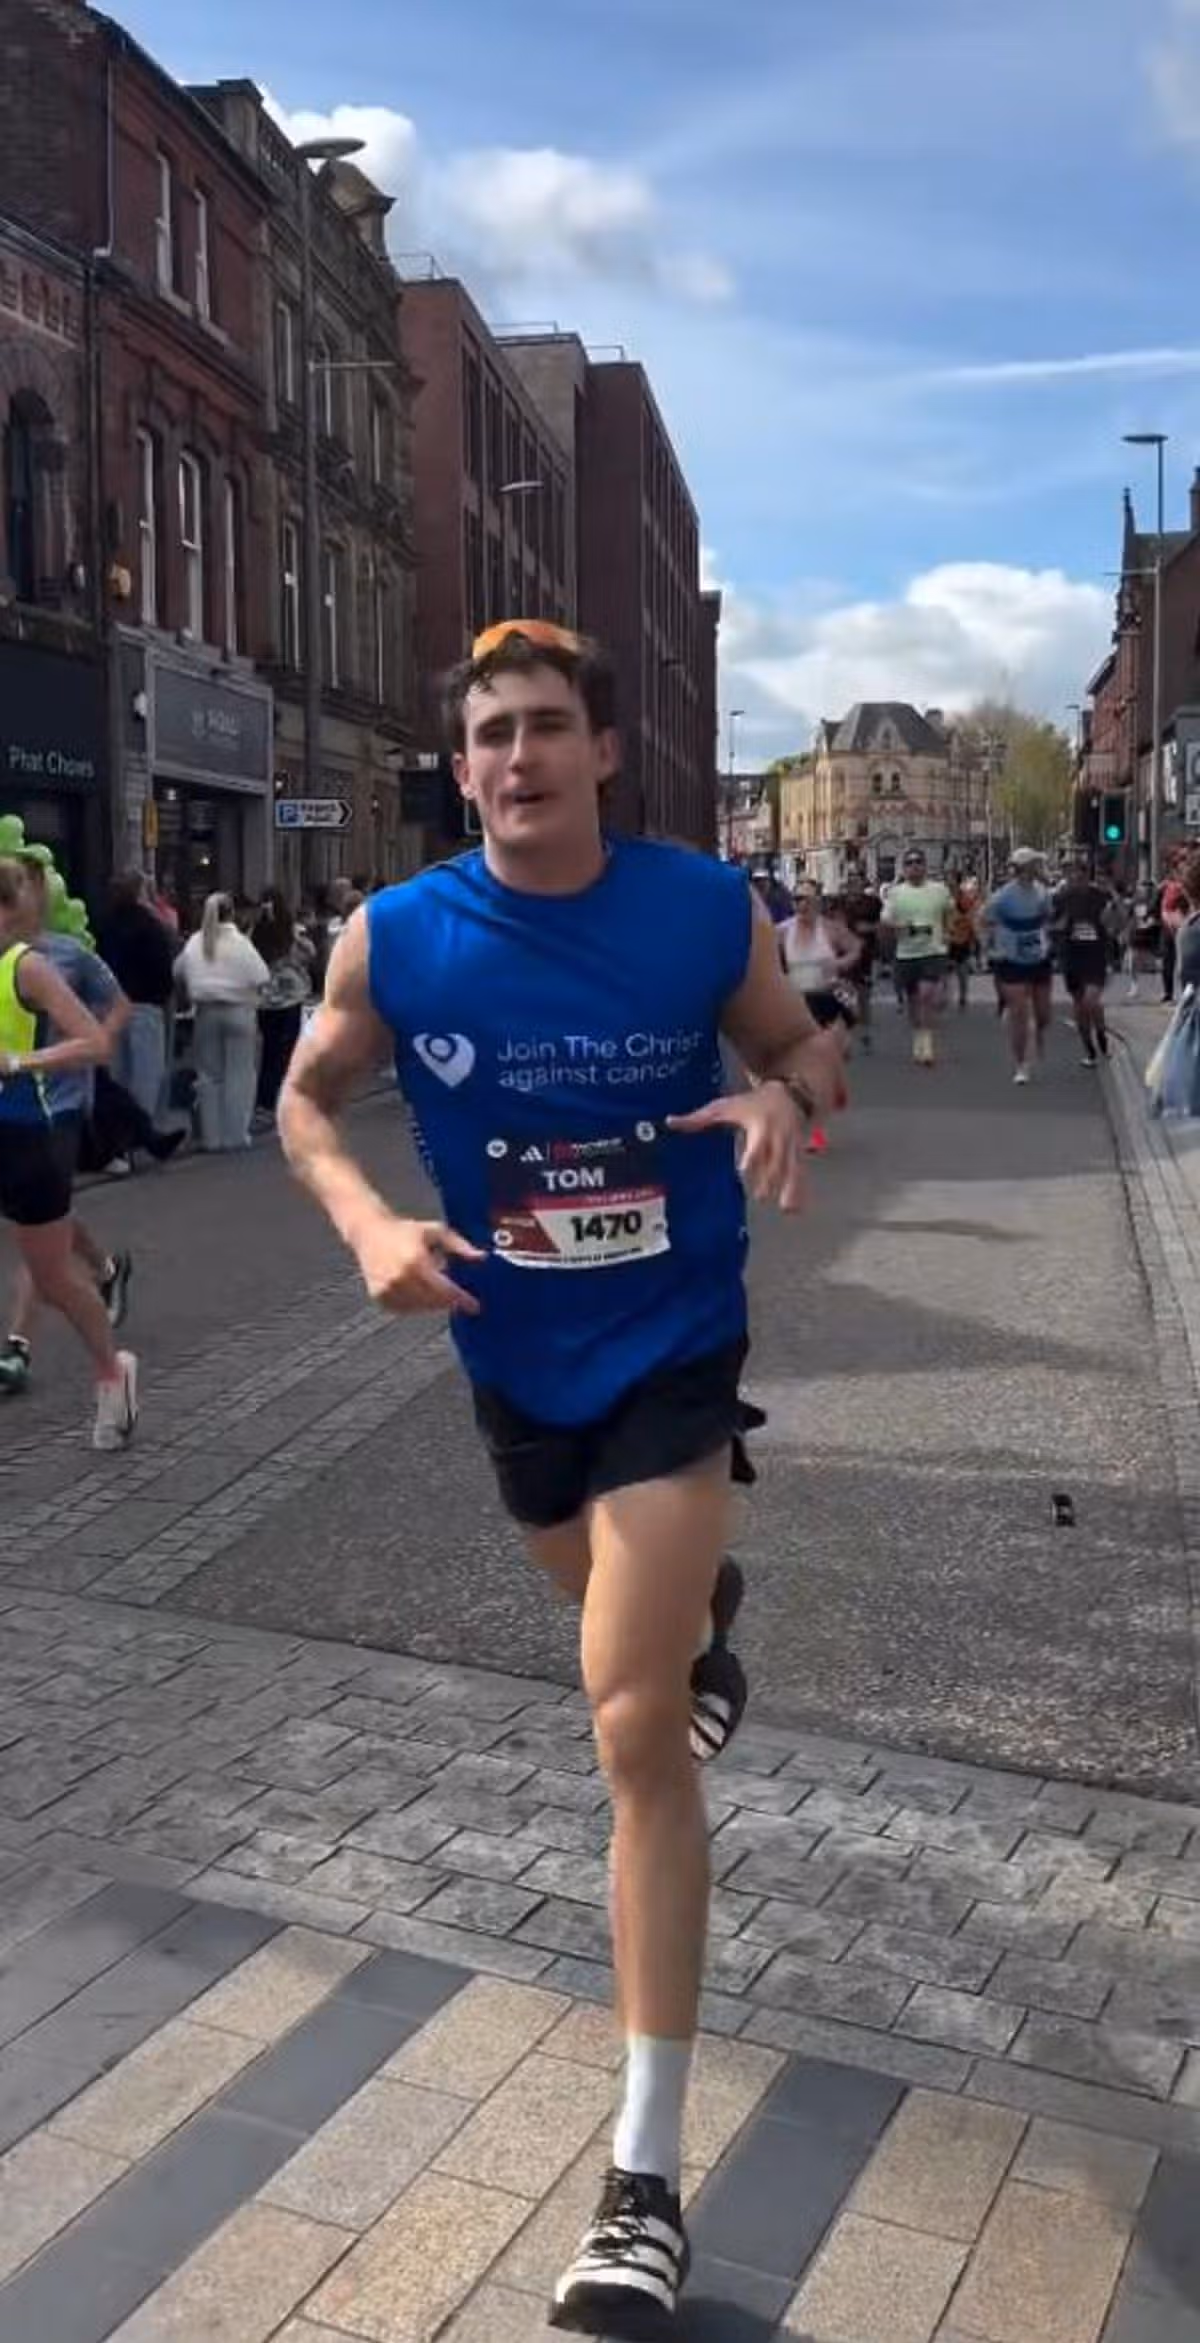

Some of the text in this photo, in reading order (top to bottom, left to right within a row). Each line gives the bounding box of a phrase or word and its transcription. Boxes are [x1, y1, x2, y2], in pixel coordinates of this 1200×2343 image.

[497, 1035, 556, 1062] Join
[562, 1034, 618, 1059] The
[499, 1063, 599, 1092] against
[542, 1167, 606, 1191] TOM
[570, 1210, 642, 1242] 1470
